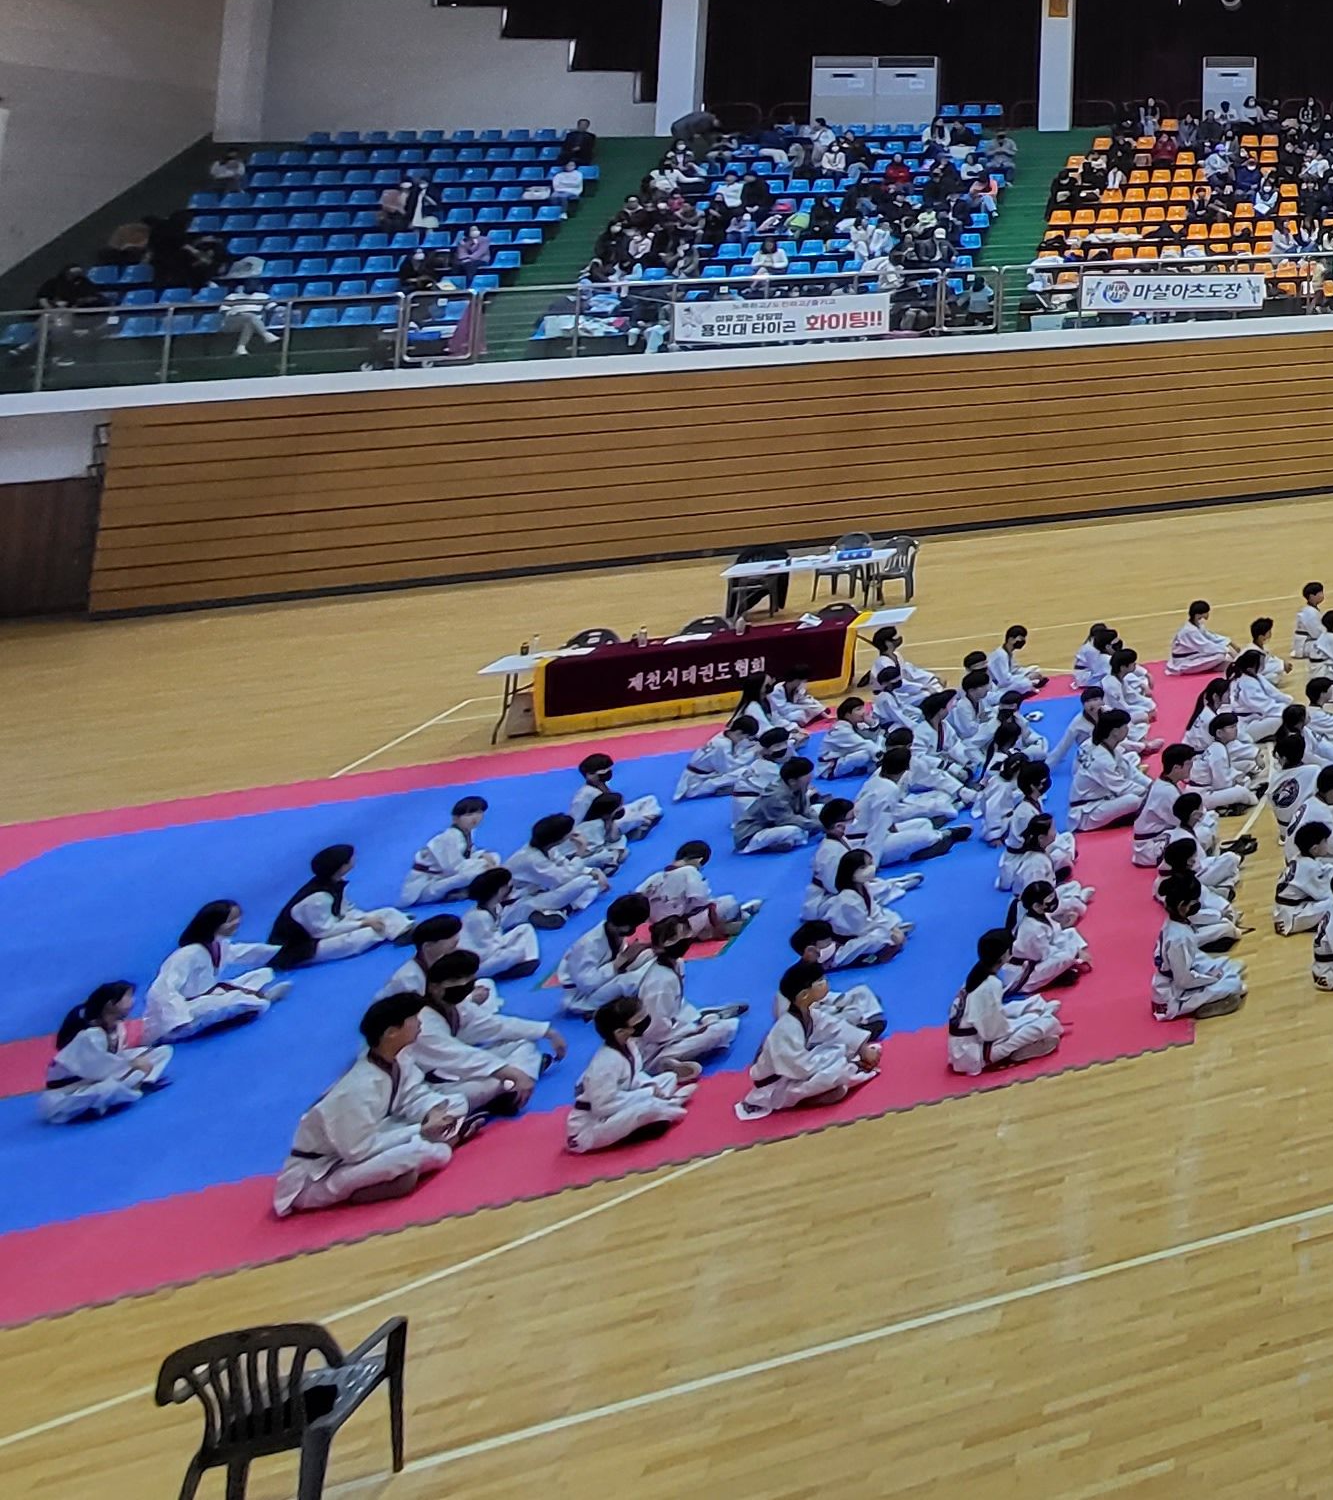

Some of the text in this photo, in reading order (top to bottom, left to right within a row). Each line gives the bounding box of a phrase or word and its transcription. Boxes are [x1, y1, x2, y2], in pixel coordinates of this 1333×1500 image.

[1132, 282, 1242, 300] 마샬아츠도장
[701, 319, 797, 337] 용인대 타이곤
[805, 310, 883, 332] 화이팅!!
